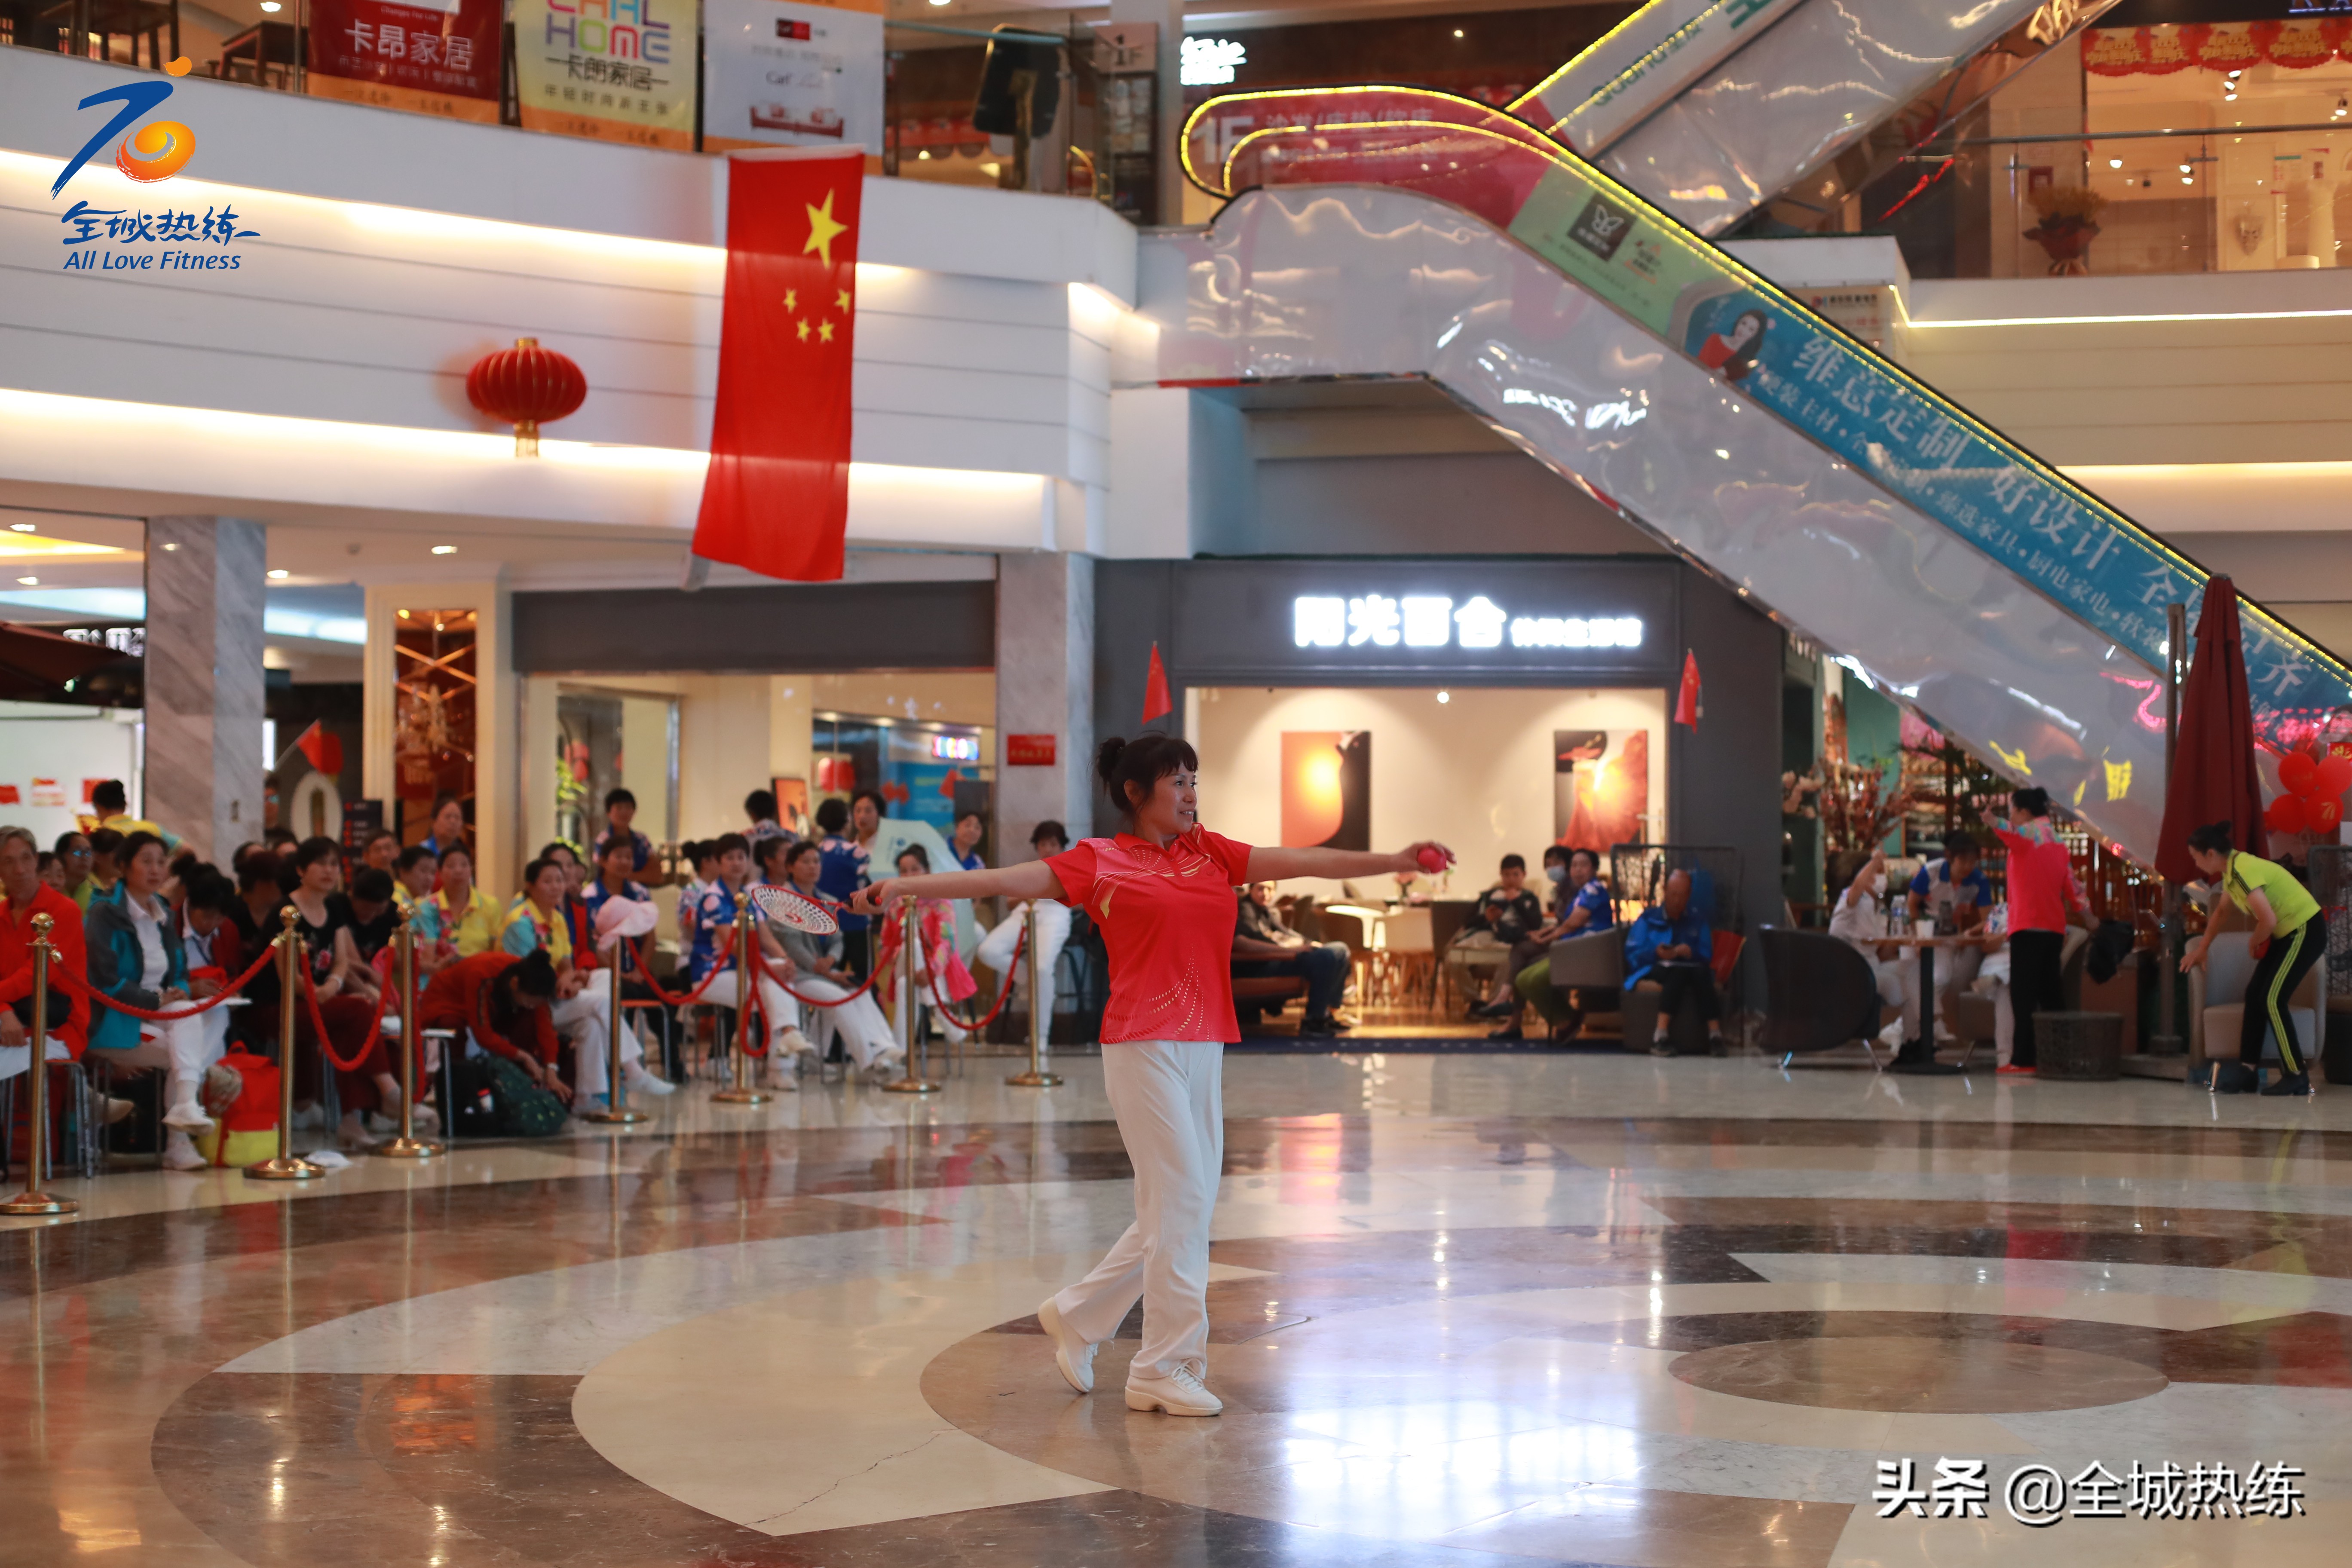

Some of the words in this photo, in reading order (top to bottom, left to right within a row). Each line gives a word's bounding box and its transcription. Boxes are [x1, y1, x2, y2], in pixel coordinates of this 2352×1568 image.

[344, 18, 473, 72] 卡昂家居
[545, 13, 671, 64] HOME
[568, 54, 652, 92] 卡朗家居
[1294, 594, 1507, 648] 阳光百合
